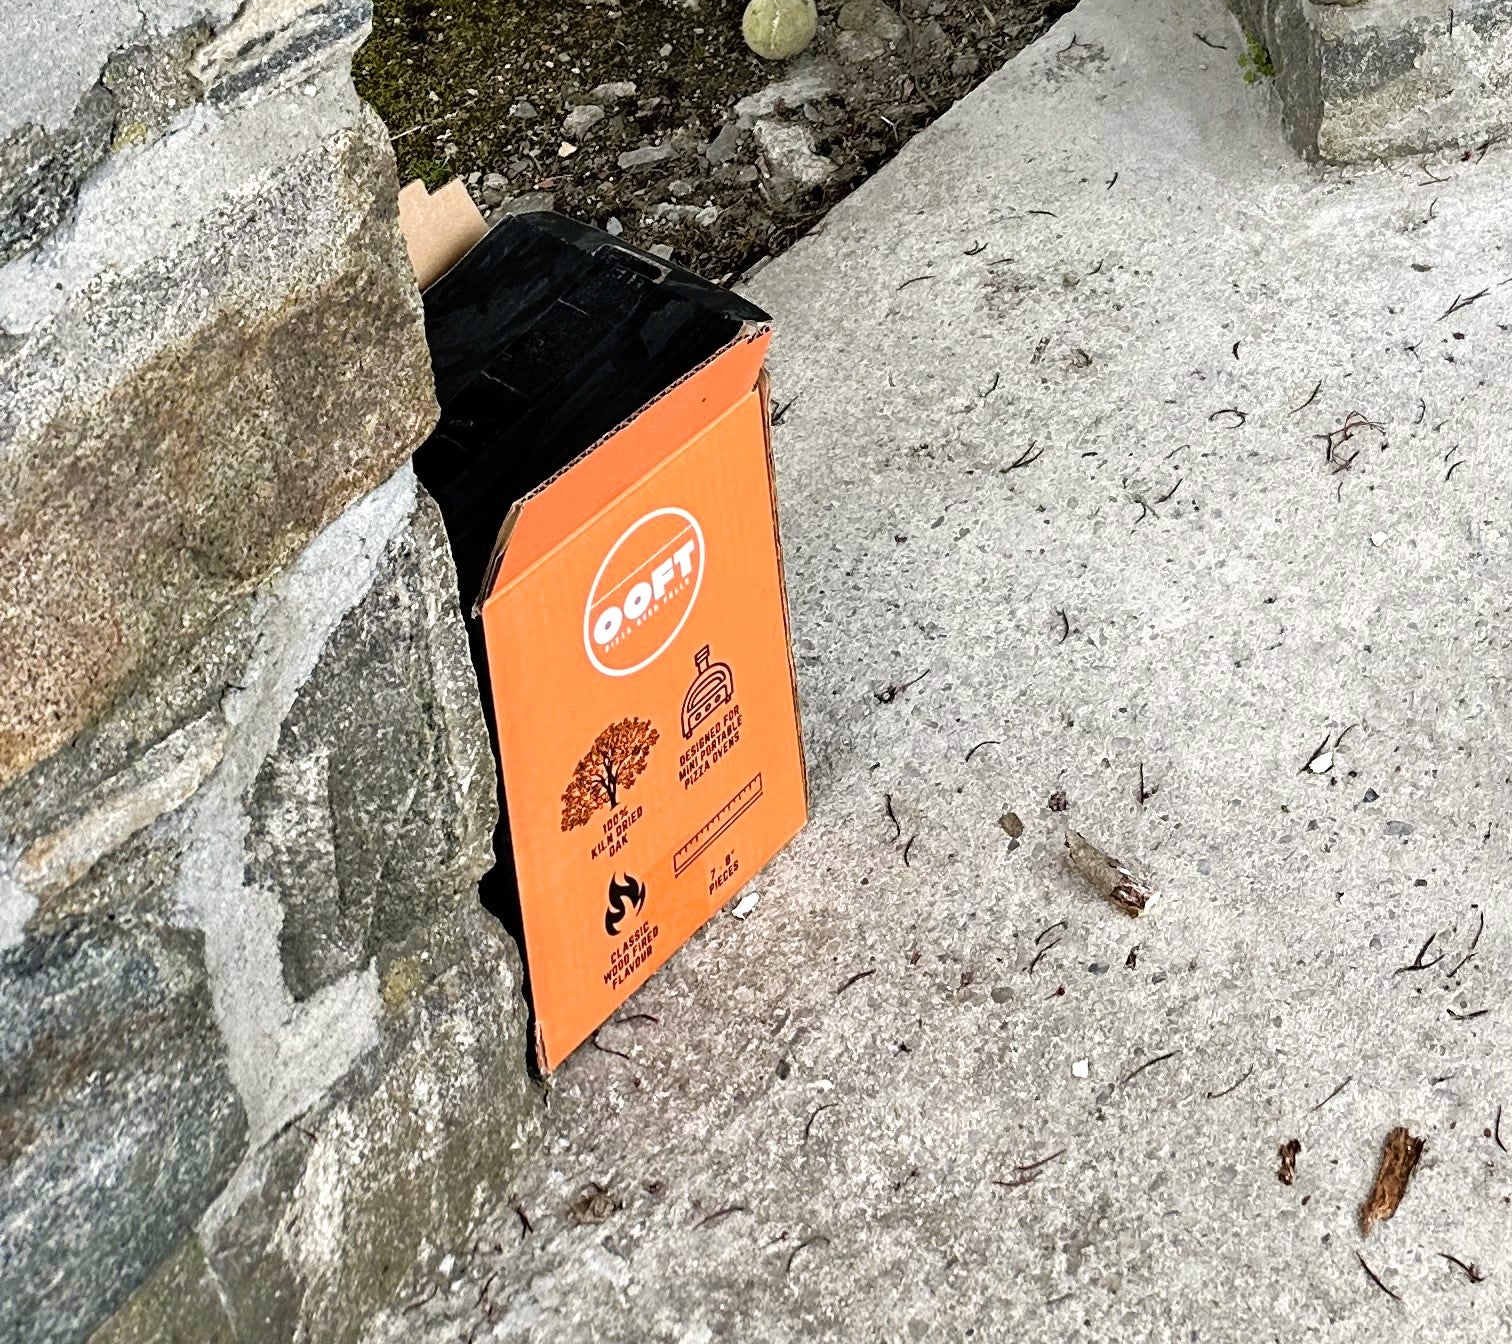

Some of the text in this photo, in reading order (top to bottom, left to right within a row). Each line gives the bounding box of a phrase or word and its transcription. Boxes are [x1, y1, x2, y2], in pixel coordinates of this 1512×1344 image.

[594, 539, 695, 644] OOFT
[679, 714, 742, 782] MINI PORTABLE
[680, 704, 739, 766] DESIGNED FOR
[685, 731, 739, 790] PIZZA OVENS
[591, 806, 643, 860] KILN DRIED
[603, 805, 628, 834] 100%
[609, 832, 628, 857] OAK
[709, 859, 738, 895] PIECES
[604, 925, 659, 984] WOOD FIRED
[611, 920, 649, 965] CLASSIC
[612, 944, 653, 991] FLAVOUR
